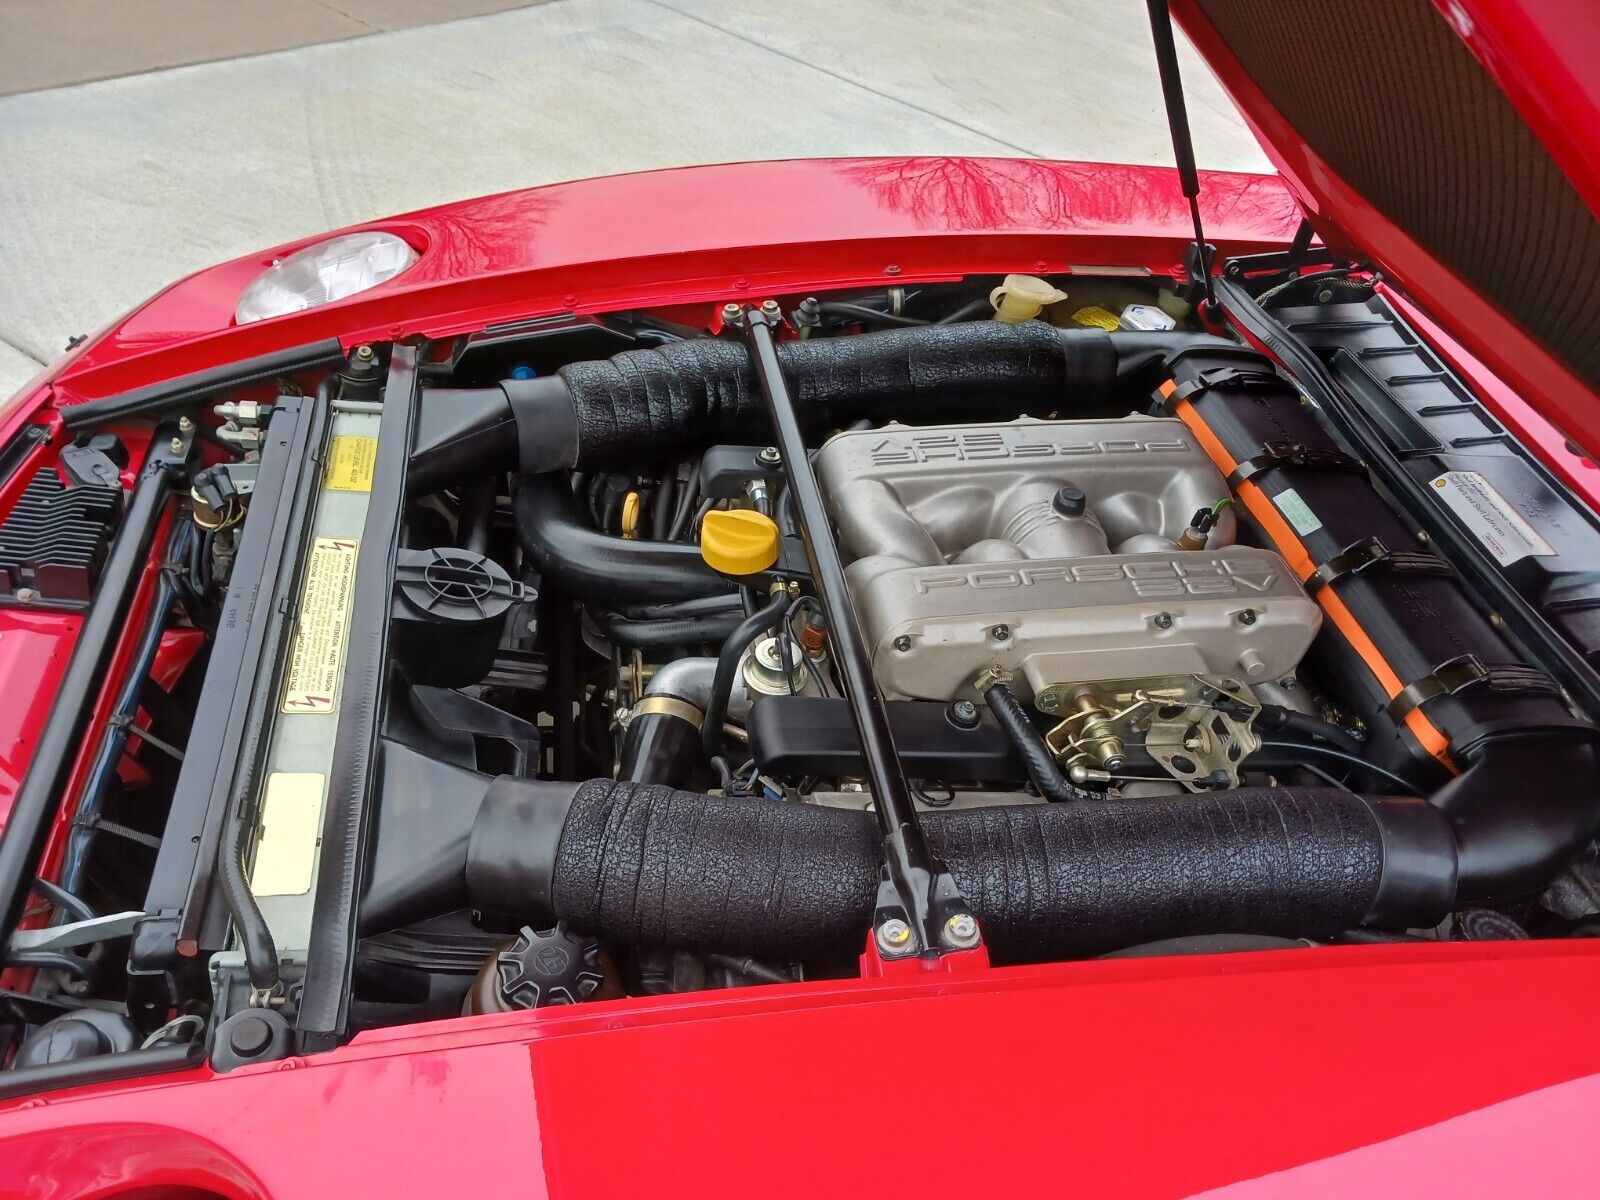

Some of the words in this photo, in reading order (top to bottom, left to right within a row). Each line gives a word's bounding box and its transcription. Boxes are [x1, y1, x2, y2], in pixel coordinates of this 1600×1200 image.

[871, 439, 1192, 466] PORSCHE
[914, 559, 1274, 594] PORSCHE
[303, 592, 312, 613] TENSIONE
[332, 620, 341, 646] ATTENTION
[289, 669, 298, 691] VOLTAGE
[325, 670, 334, 691] TENSION
